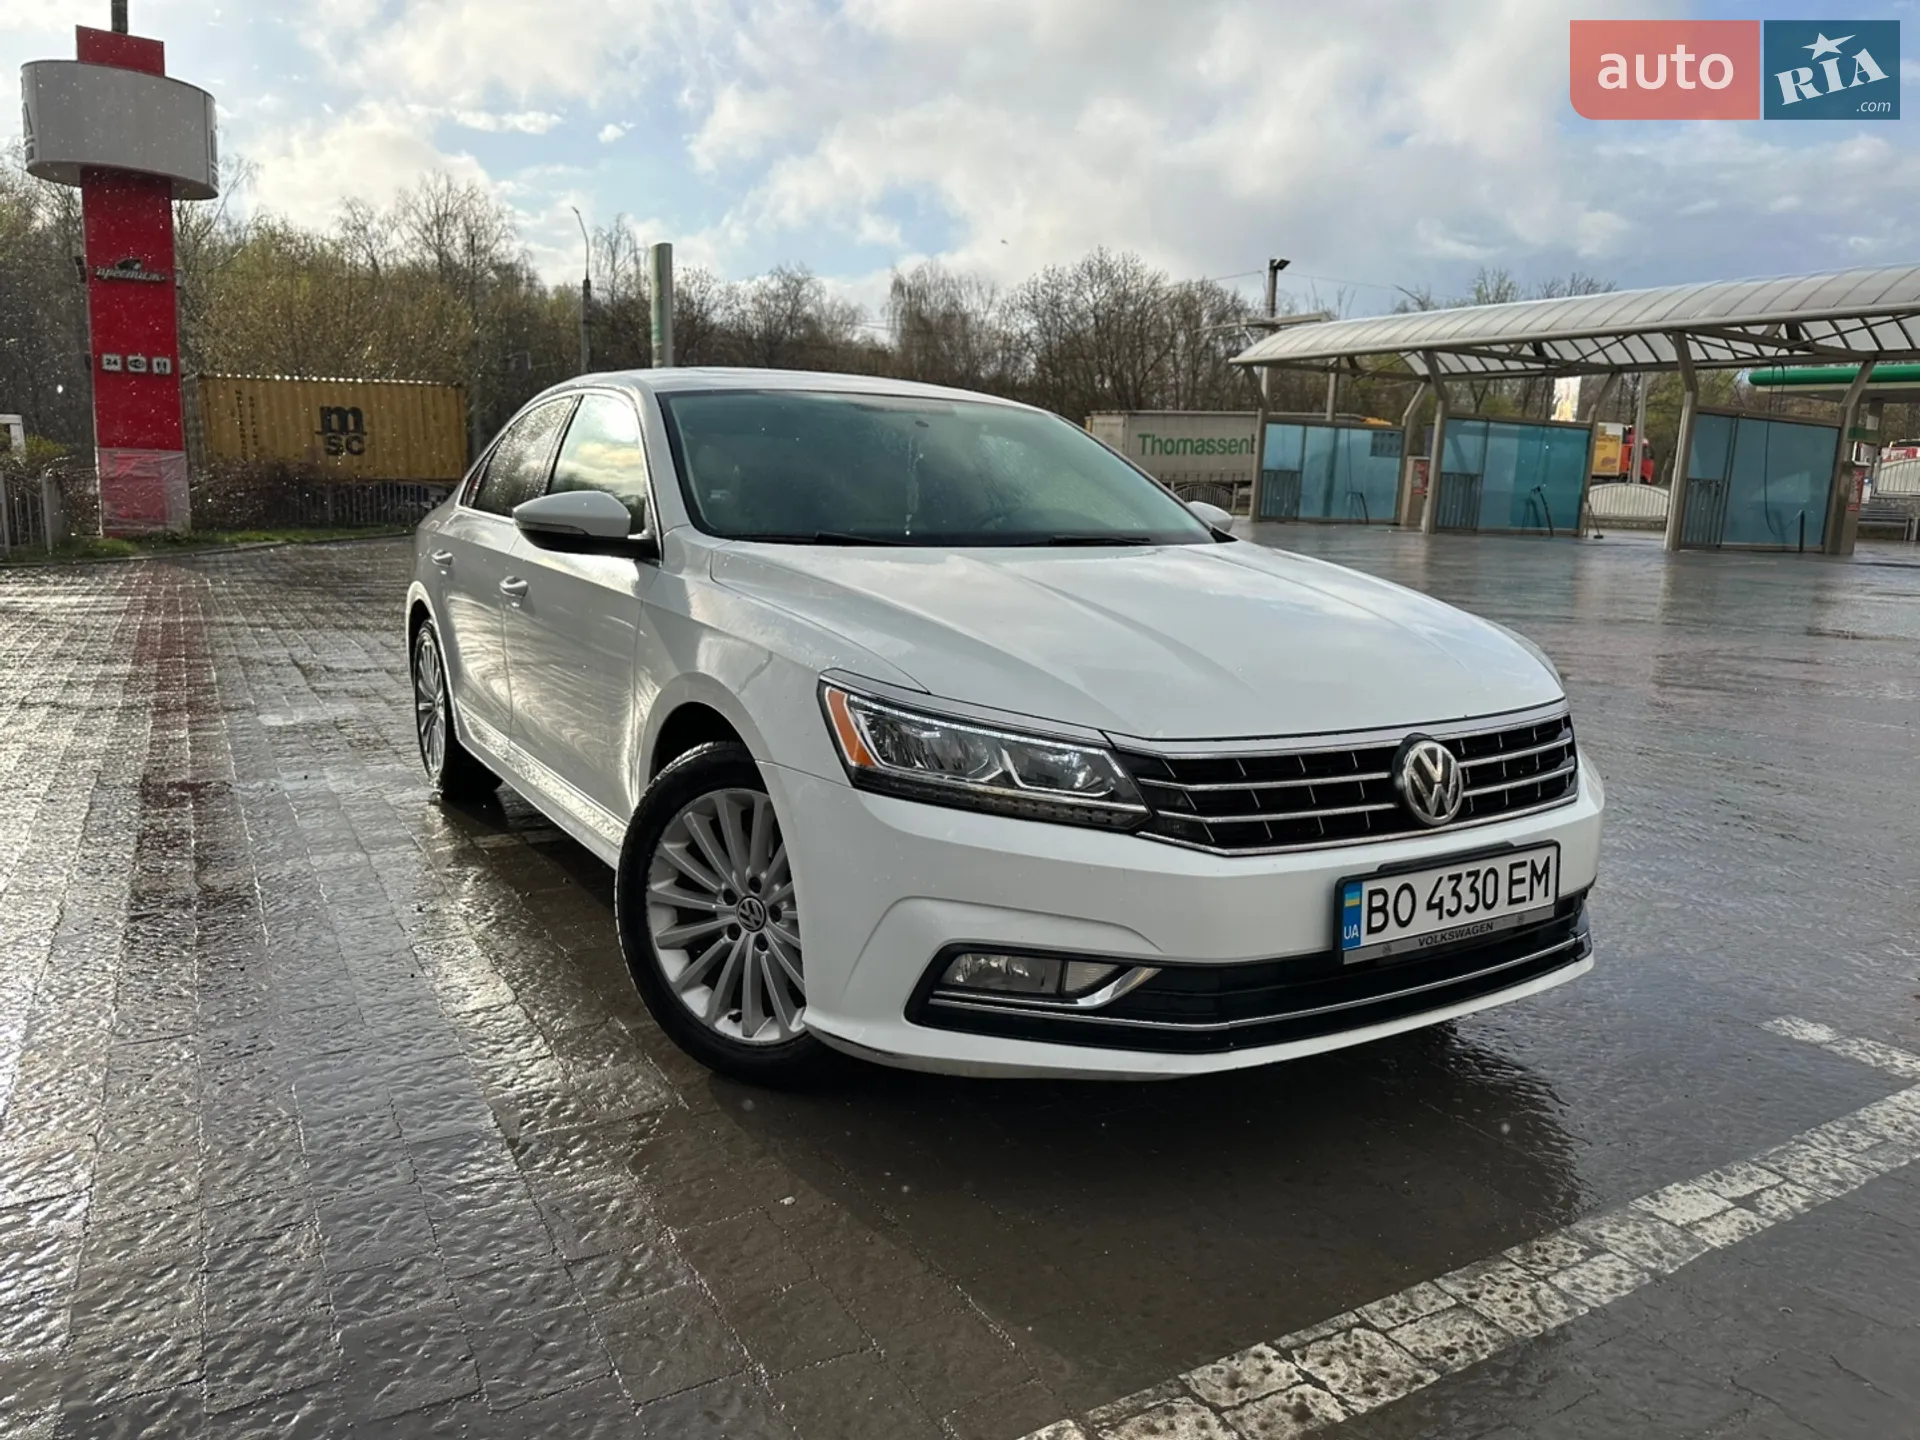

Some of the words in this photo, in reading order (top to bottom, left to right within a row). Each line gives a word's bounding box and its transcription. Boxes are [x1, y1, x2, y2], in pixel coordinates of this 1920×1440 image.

[106, 358, 118, 366] 24
[1366, 882, 1417, 935] BO
[1426, 867, 1499, 920] 4330
[1507, 856, 1551, 906] EM
[1344, 924, 1359, 940] UA
[1418, 922, 1494, 947] VOLKSWAGEN
